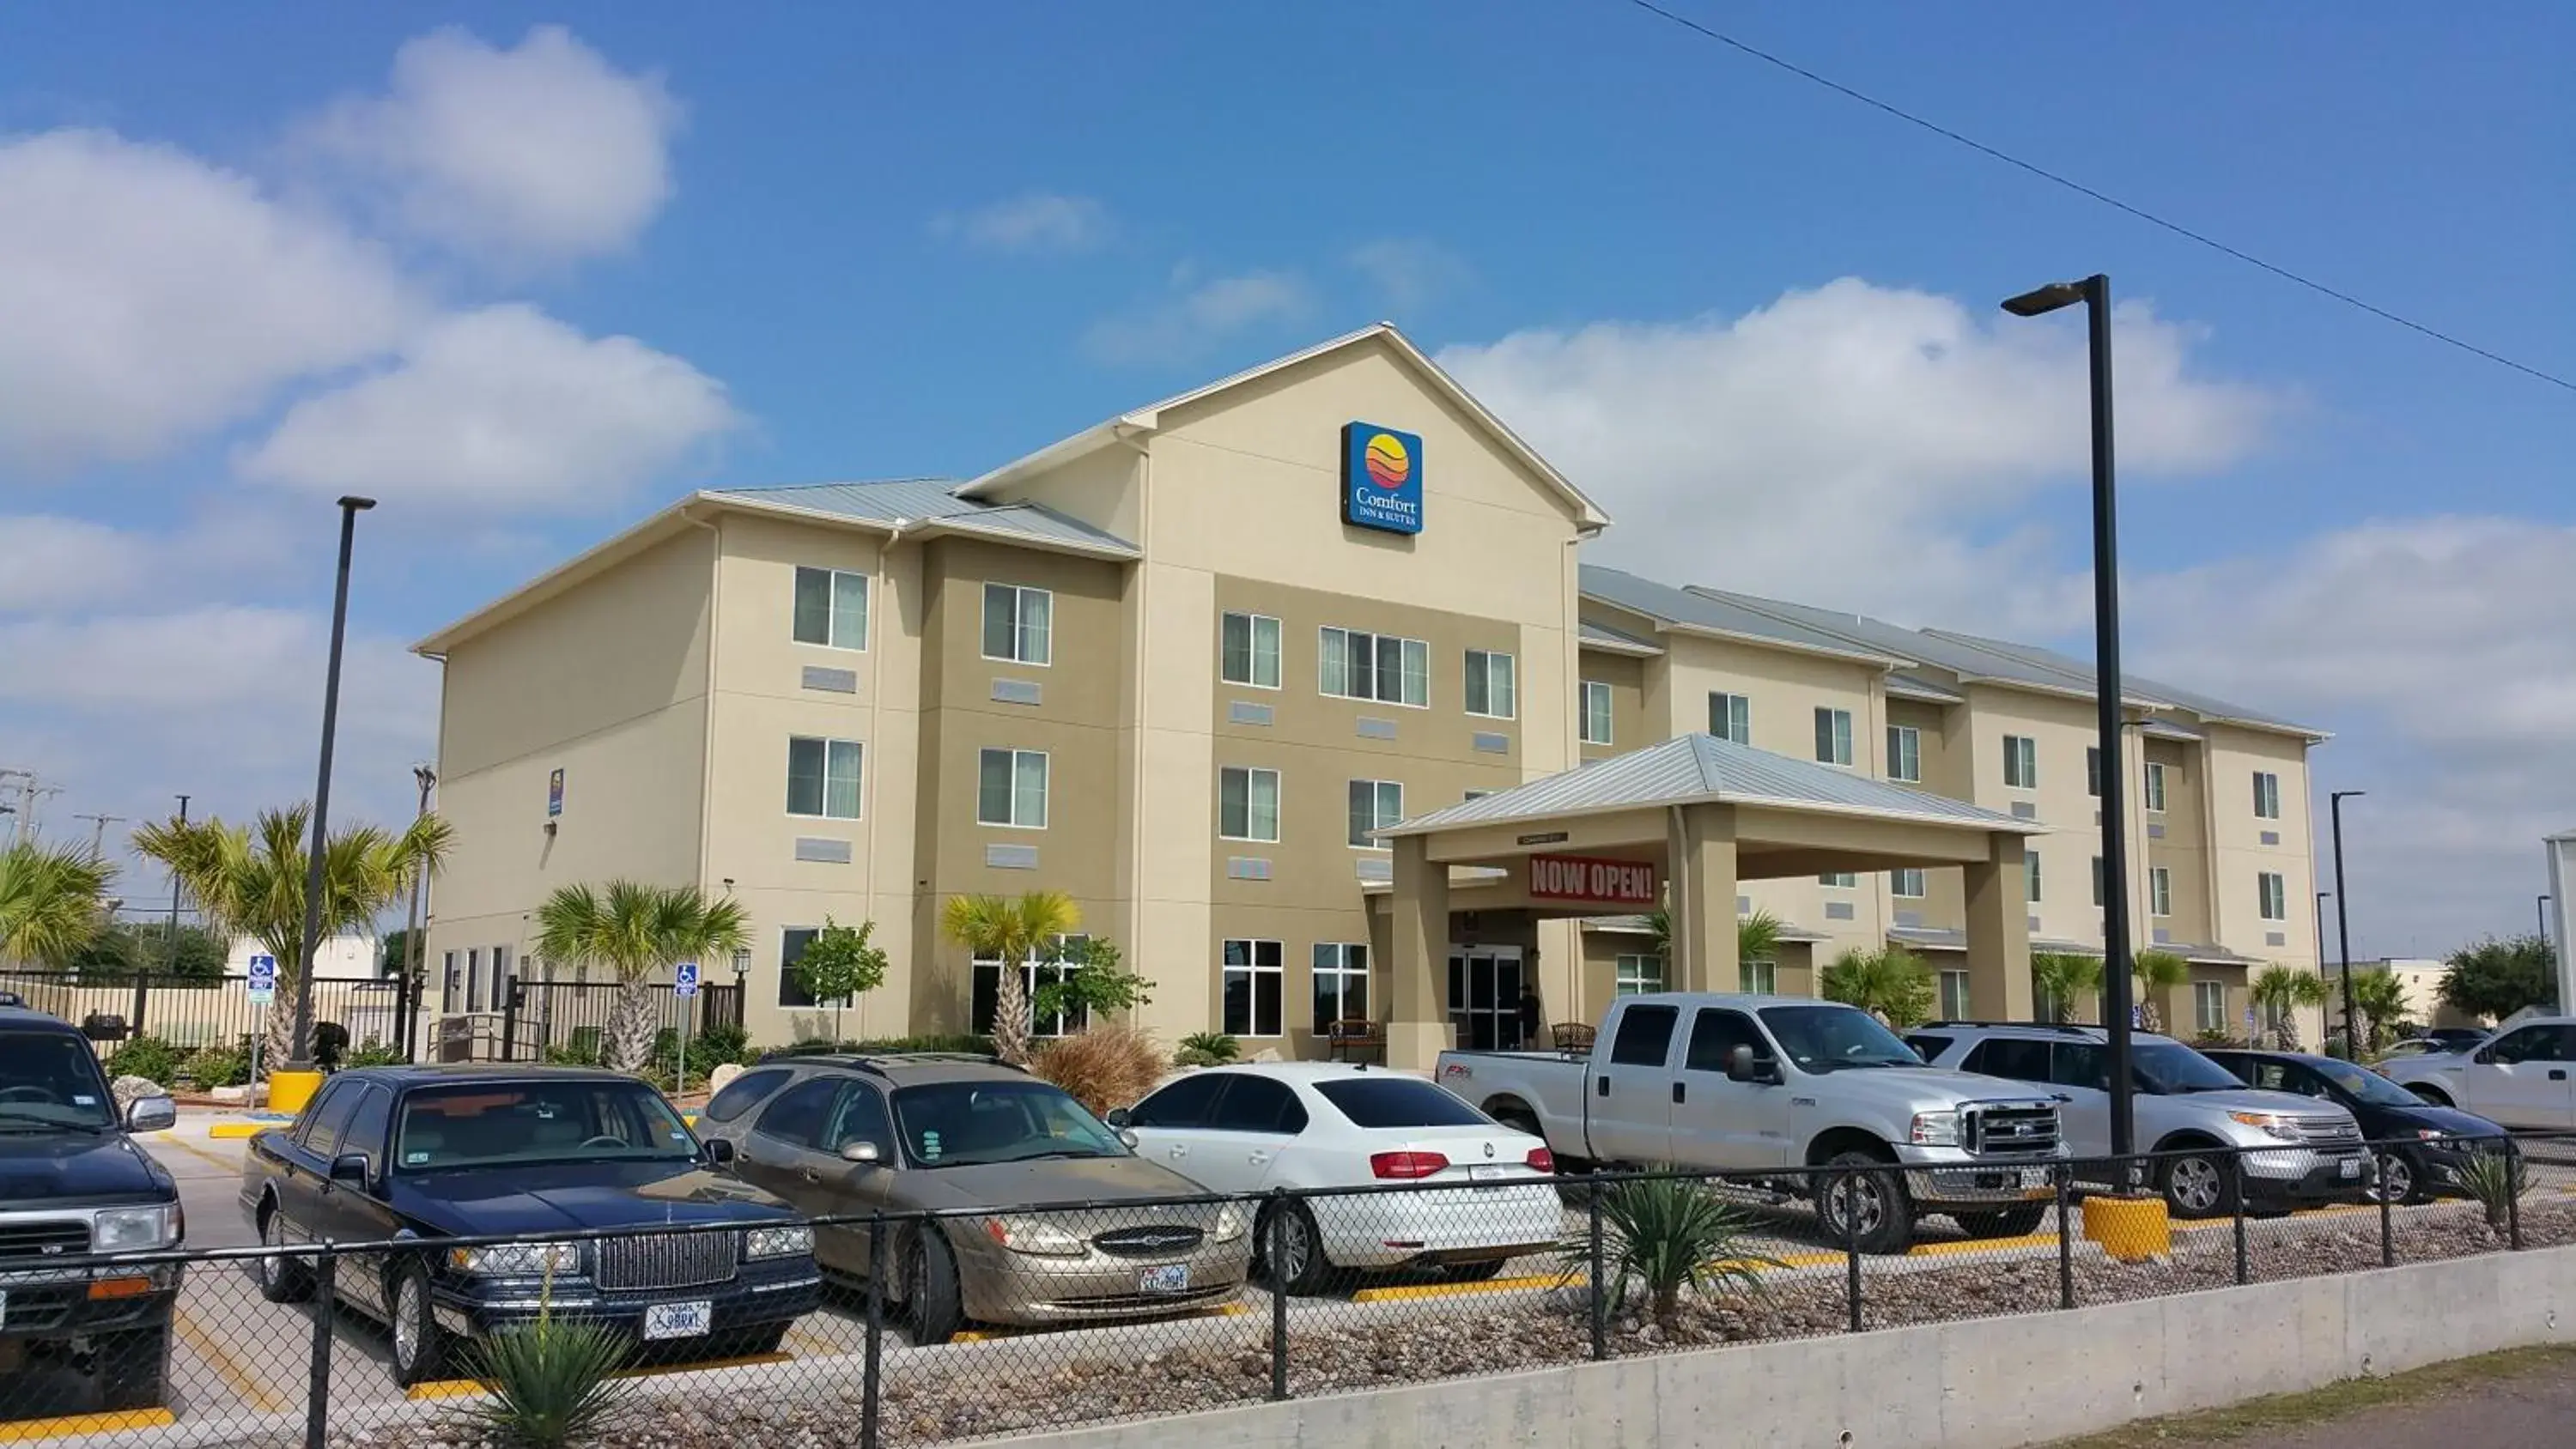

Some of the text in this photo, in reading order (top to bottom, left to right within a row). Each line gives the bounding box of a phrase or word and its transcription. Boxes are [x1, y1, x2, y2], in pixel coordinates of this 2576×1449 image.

[1356, 487, 1415, 513] Comfort
[1359, 506, 1416, 525] INN & SUITES
[1531, 859, 1653, 900] NOW OPEN!
